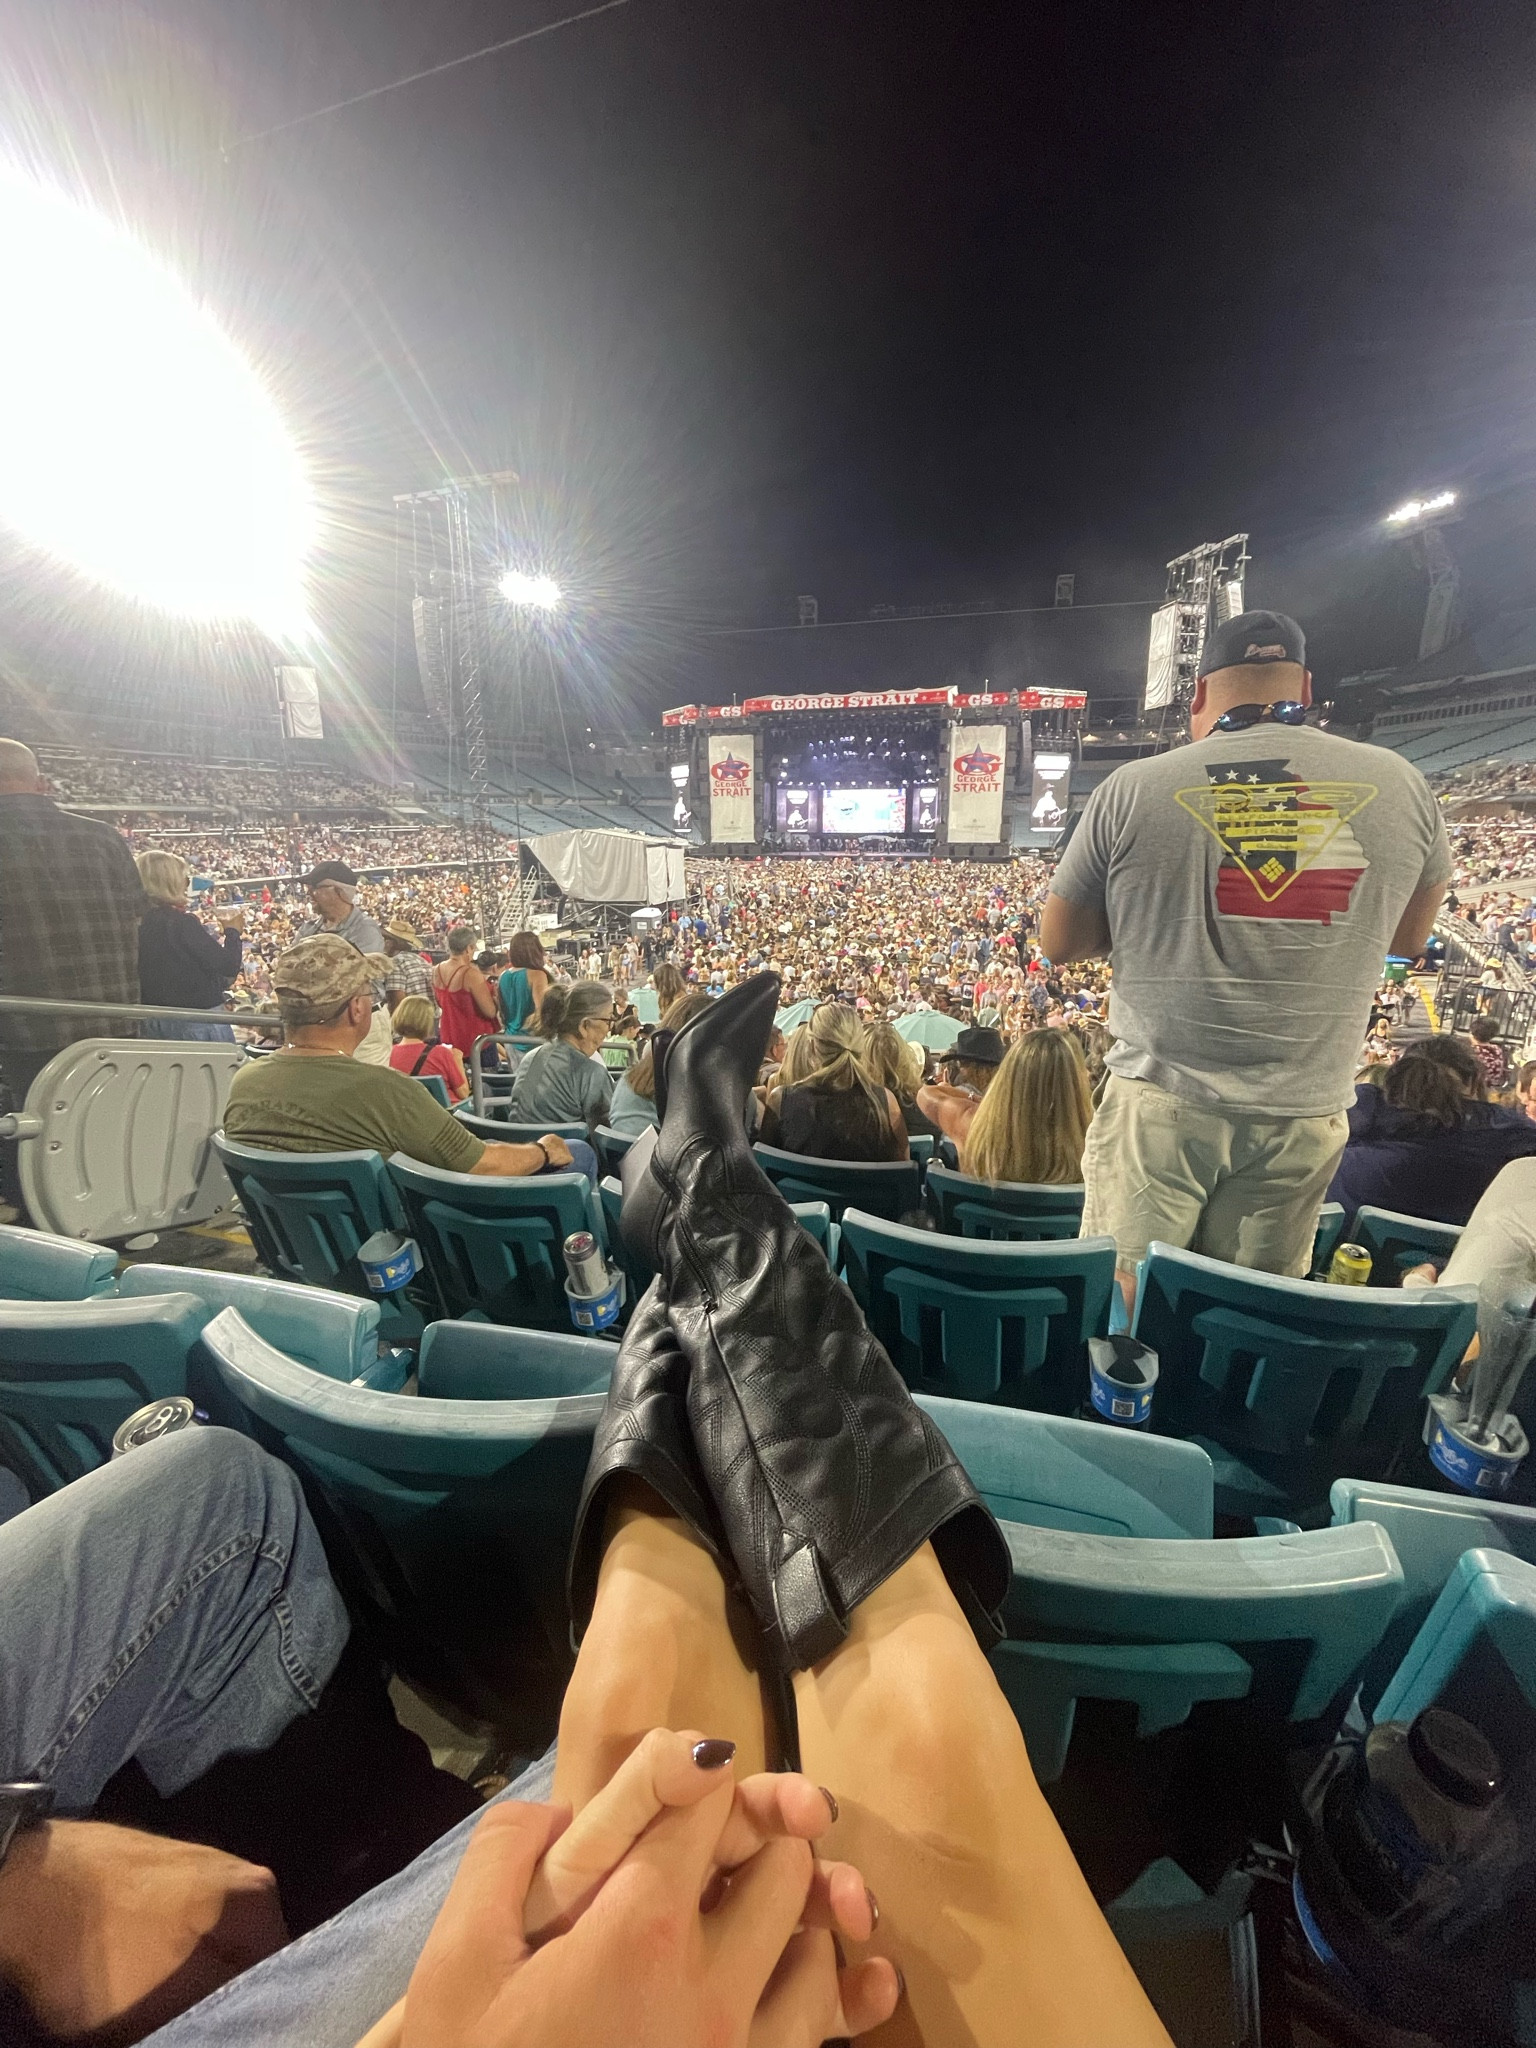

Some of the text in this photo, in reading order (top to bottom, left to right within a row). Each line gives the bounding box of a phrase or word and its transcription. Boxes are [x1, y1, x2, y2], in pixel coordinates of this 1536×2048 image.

[771, 692, 919, 711] GEORGE STRAIT
[968, 694, 993, 706] GS
[1040, 697, 1065, 709] GS
[720, 706, 742, 717] GS
[957, 773, 997, 783] GEORGE
[714, 780, 748, 788] GEORGE
[953, 782, 1001, 794] STRAIT
[712, 787, 752, 798] STRAIT
